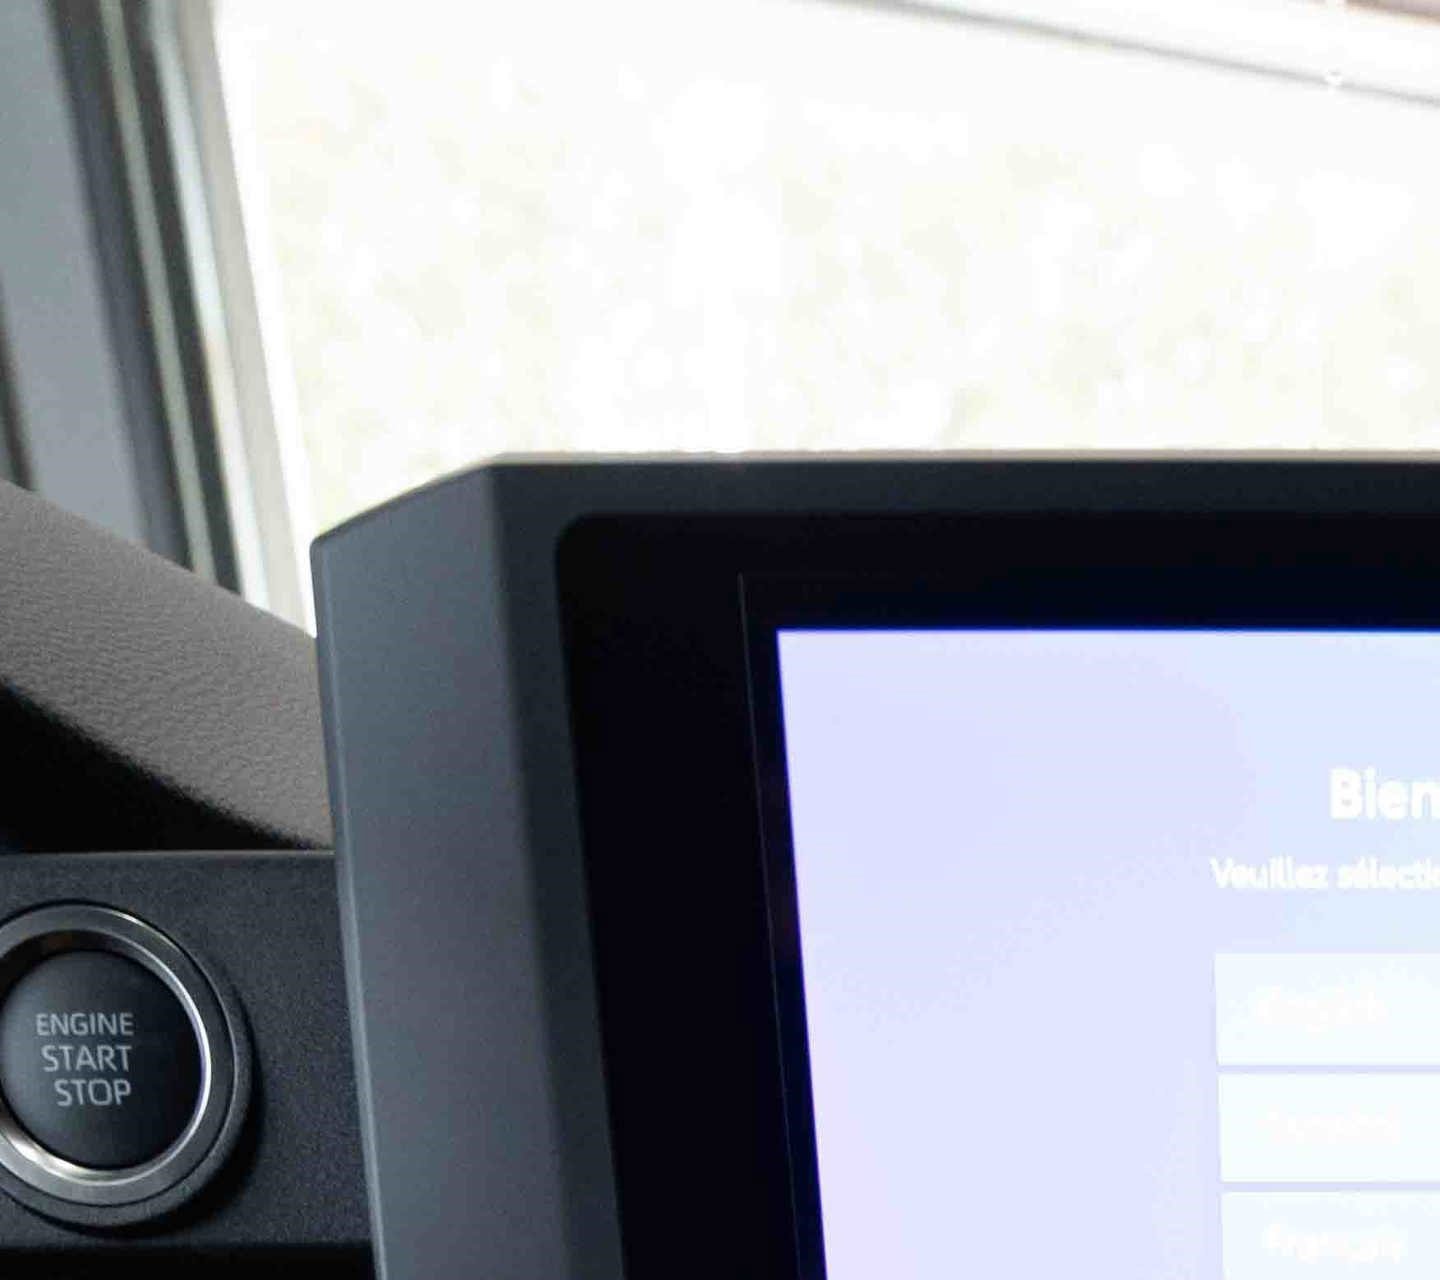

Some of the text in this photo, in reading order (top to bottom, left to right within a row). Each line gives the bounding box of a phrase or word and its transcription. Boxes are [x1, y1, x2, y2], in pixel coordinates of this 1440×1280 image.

[1210, 857, 1328, 891] Veuillez
[35, 1012, 136, 1036] ENGINE
[40, 1044, 134, 1072] START
[54, 1078, 133, 1107] STOP
